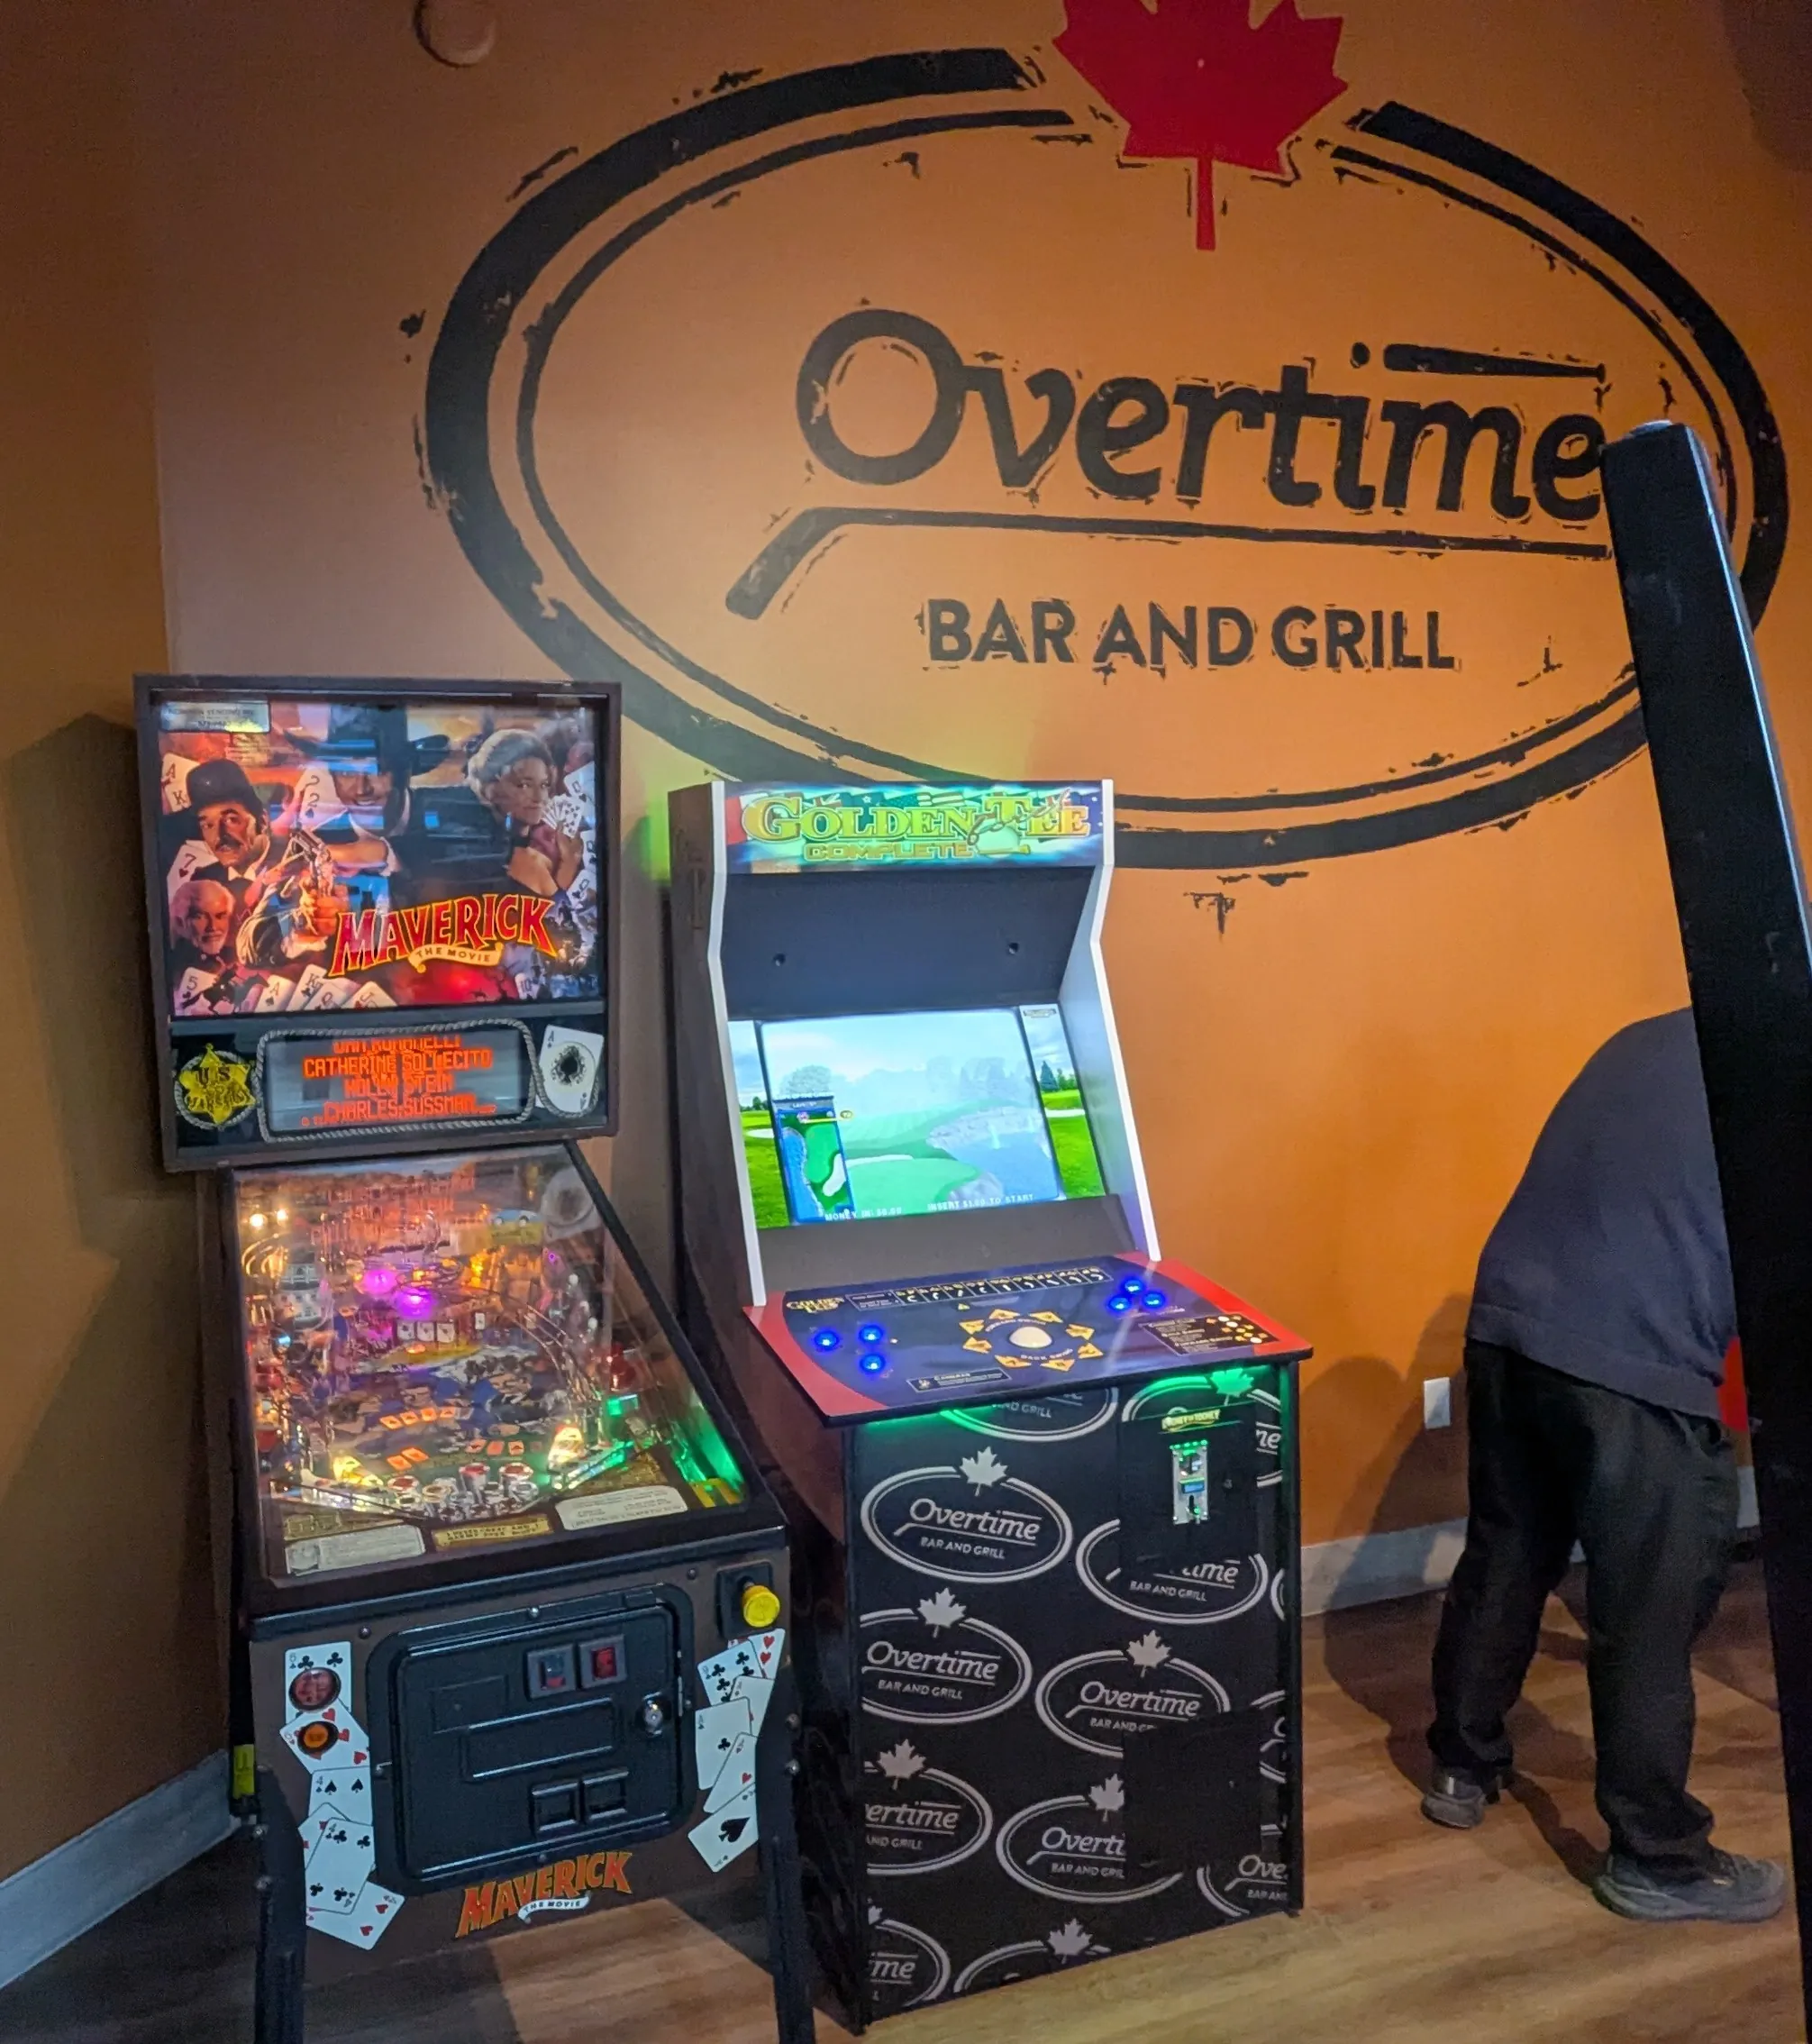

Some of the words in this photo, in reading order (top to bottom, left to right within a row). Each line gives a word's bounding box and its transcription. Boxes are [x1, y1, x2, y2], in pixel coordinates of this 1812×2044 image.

[797, 309, 1606, 520] Overtime
[926, 598, 1079, 665] BAR
[1092, 602, 1257, 670] AND
[1271, 606, 1455, 671] GRILL
[742, 796, 979, 842] GOLDEN
[983, 794, 1089, 838] TEE
[805, 840, 975, 861] COMPLETE
[328, 893, 558, 977] MAVERICK
[414, 946, 443, 959] THE
[447, 949, 492, 963] MOVIE
[304, 1054, 397, 1079] CATHERINE
[927, 1201, 960, 1211] INSERT
[1005, 1193, 1034, 1204] START
[1021, 1404, 1052, 1419] GRILL
[909, 1498, 1041, 1541] Overtime
[920, 1537, 943, 1548] BAR
[943, 1542, 973, 1555] AND
[973, 1546, 1006, 1560] GRILL
[1129, 1580, 1152, 1592] BAR
[1152, 1585, 1177, 1597] AND
[1178, 1588, 1208, 1602] GRILL
[867, 1640, 999, 1680] Overtime
[877, 1679, 902, 1693] BAR
[902, 1684, 930, 1695] AND
[931, 1686, 963, 1701] GRILL
[1080, 1681, 1200, 1717] Overtime
[1089, 1717, 1112, 1729] BAR
[1113, 1720, 1137, 1732] AND
[1051, 1862, 1074, 1874] BAR
[1074, 1865, 1099, 1876] AND
[454, 1851, 633, 1938] MAVERICK
[524, 1902, 544, 1913] THE
[546, 1900, 582, 1909] MOVIE
